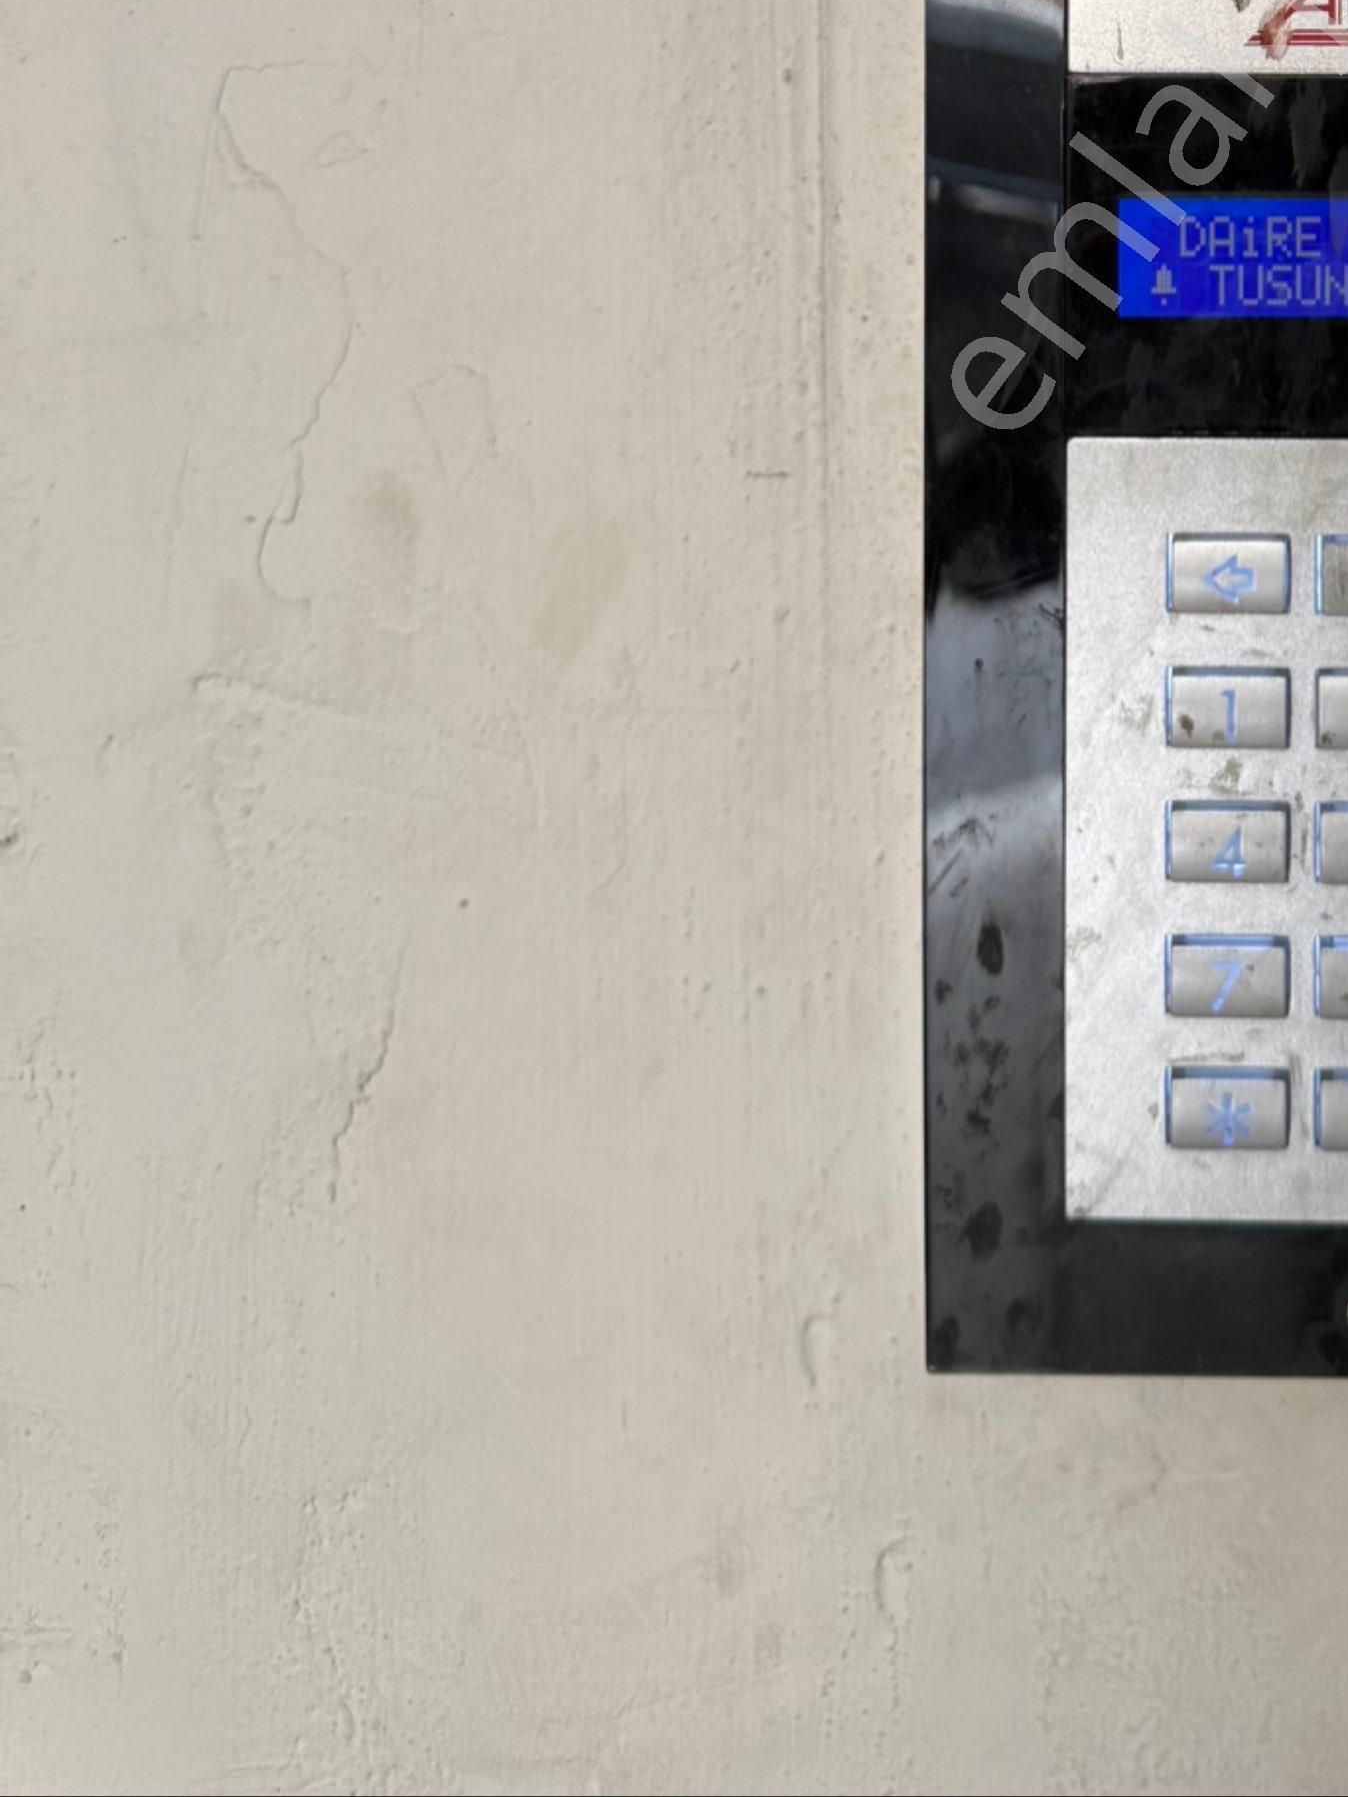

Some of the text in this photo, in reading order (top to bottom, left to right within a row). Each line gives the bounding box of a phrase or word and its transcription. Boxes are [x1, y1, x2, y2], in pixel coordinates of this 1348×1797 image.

[1220, 690, 1238, 742] 1
[1211, 826, 1246, 876] 4
[1211, 960, 1242, 1010] 7
